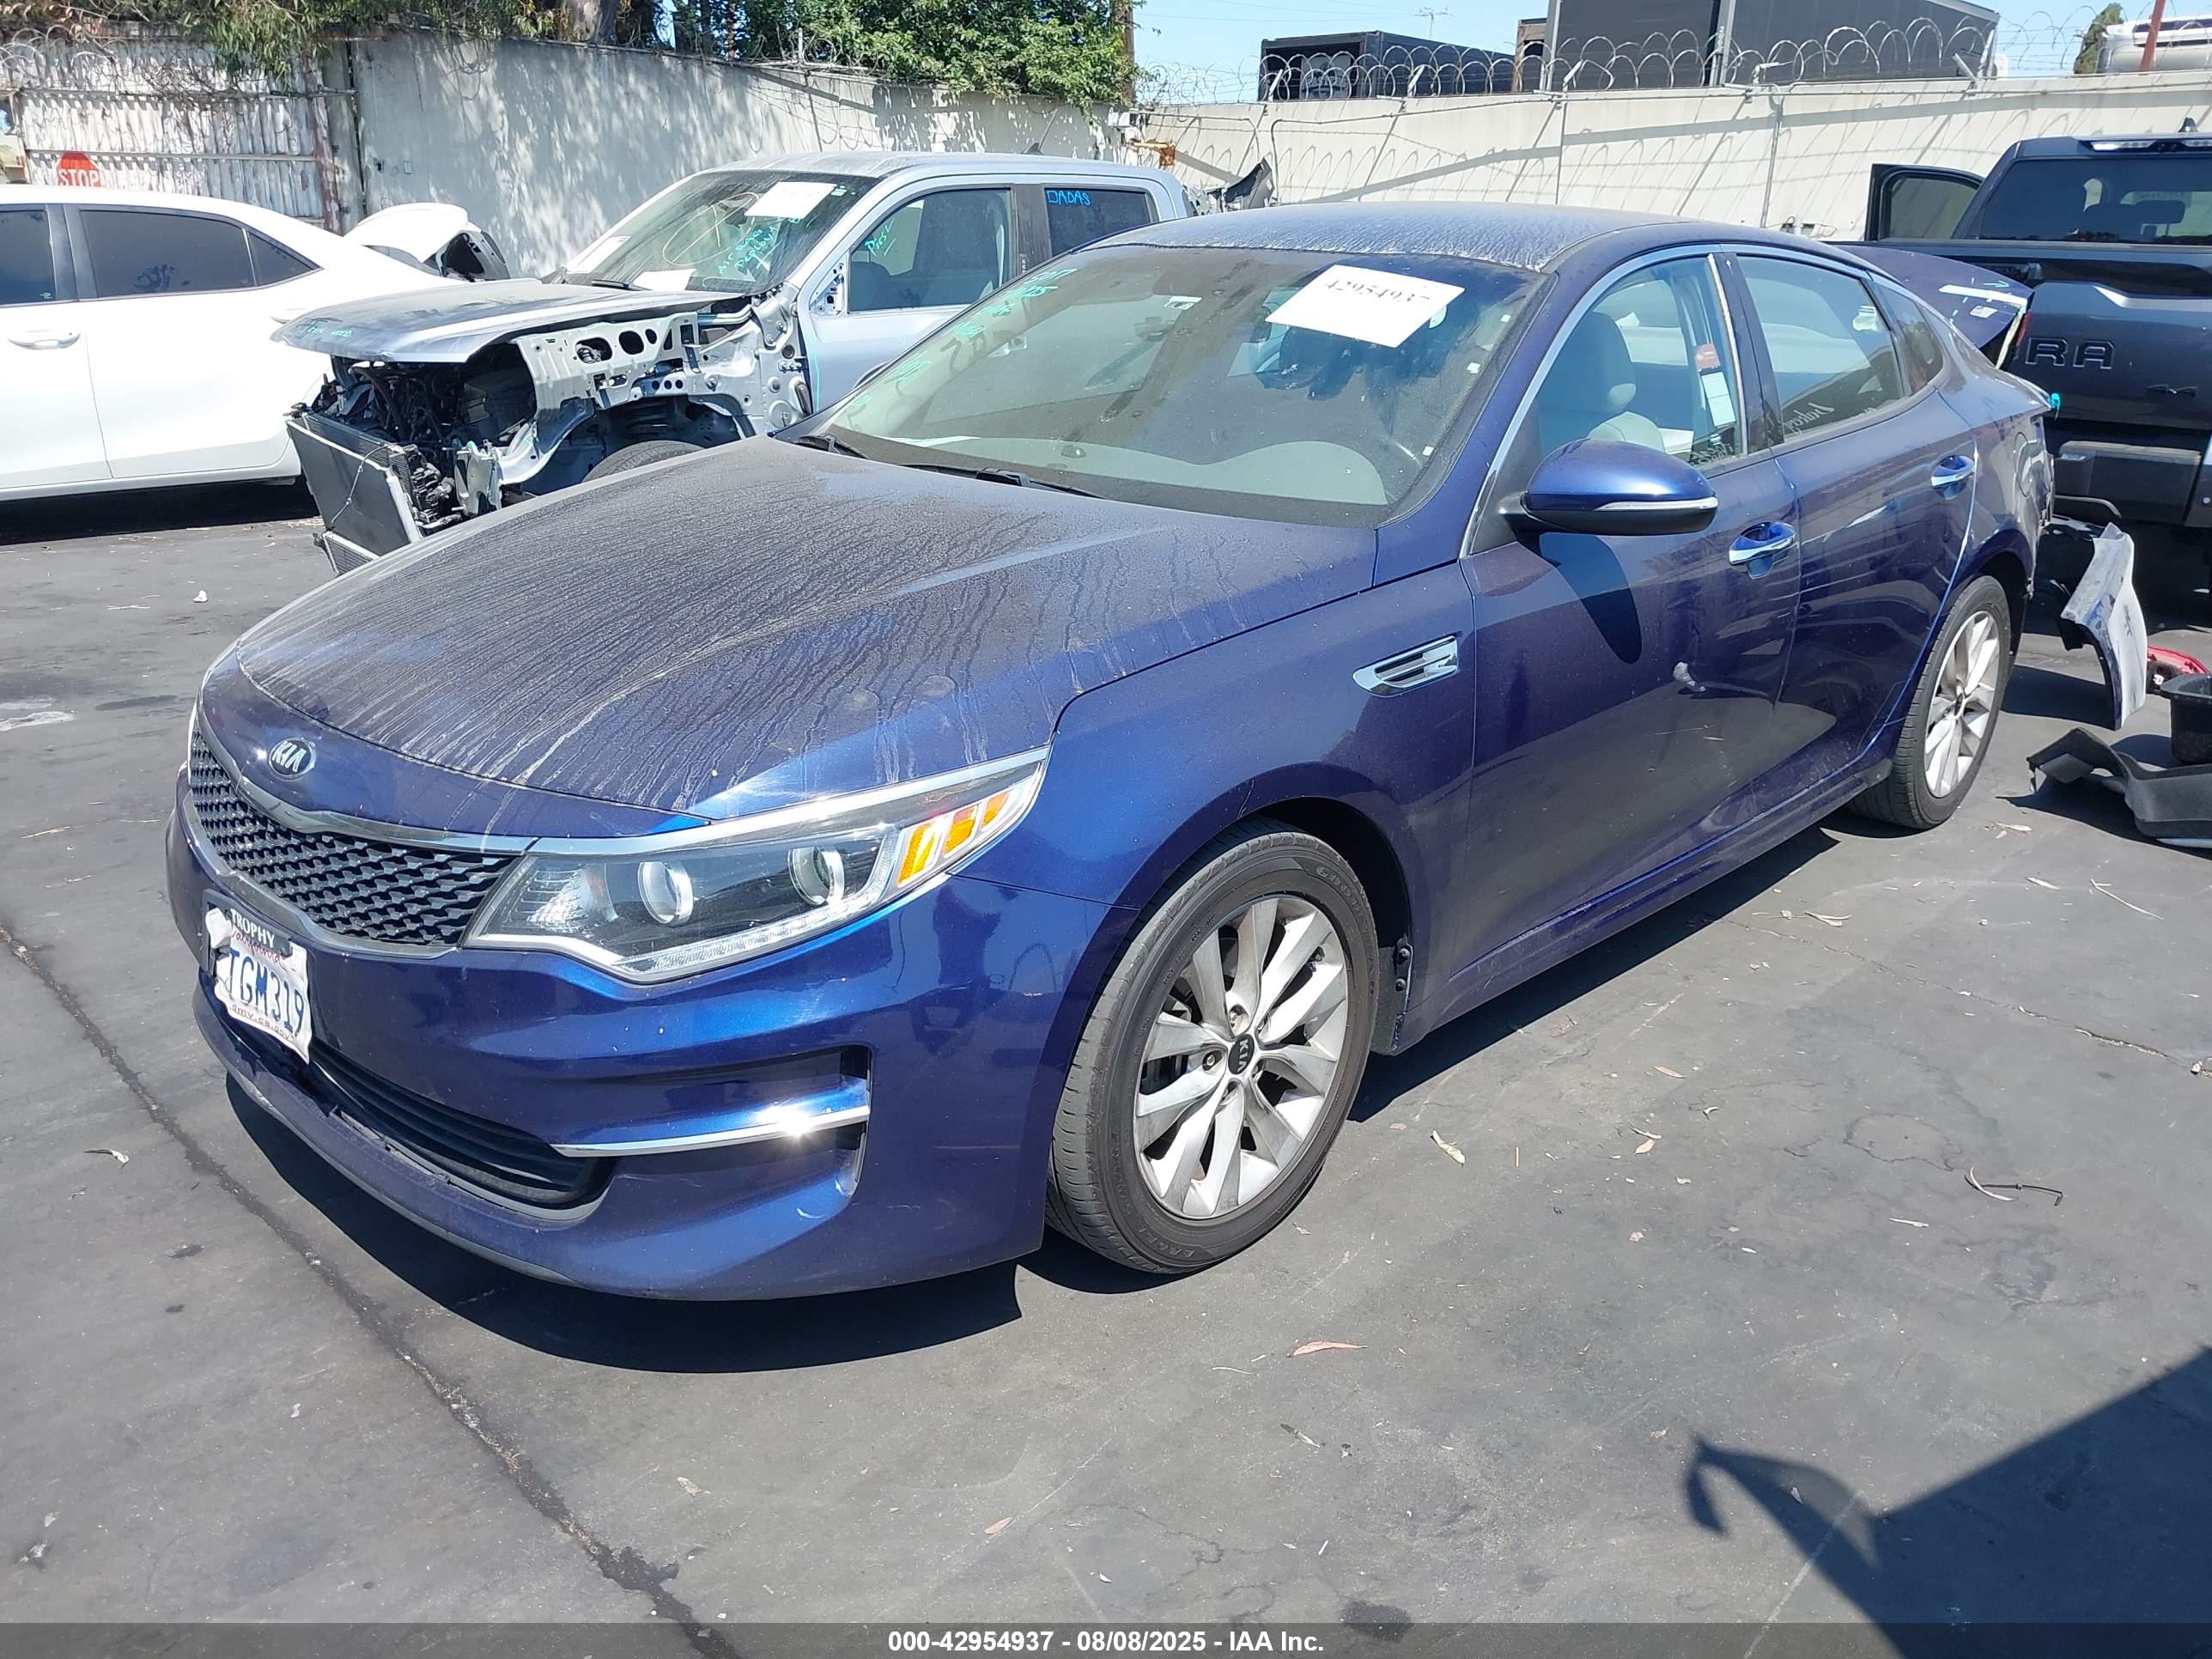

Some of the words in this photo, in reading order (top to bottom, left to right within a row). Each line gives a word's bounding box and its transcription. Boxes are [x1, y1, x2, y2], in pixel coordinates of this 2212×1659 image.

[58, 167, 100, 188] STOP
[271, 740, 307, 773] KIA
[230, 907, 275, 949] TROPHY
[1237, 1039, 1249, 1073] KIA
